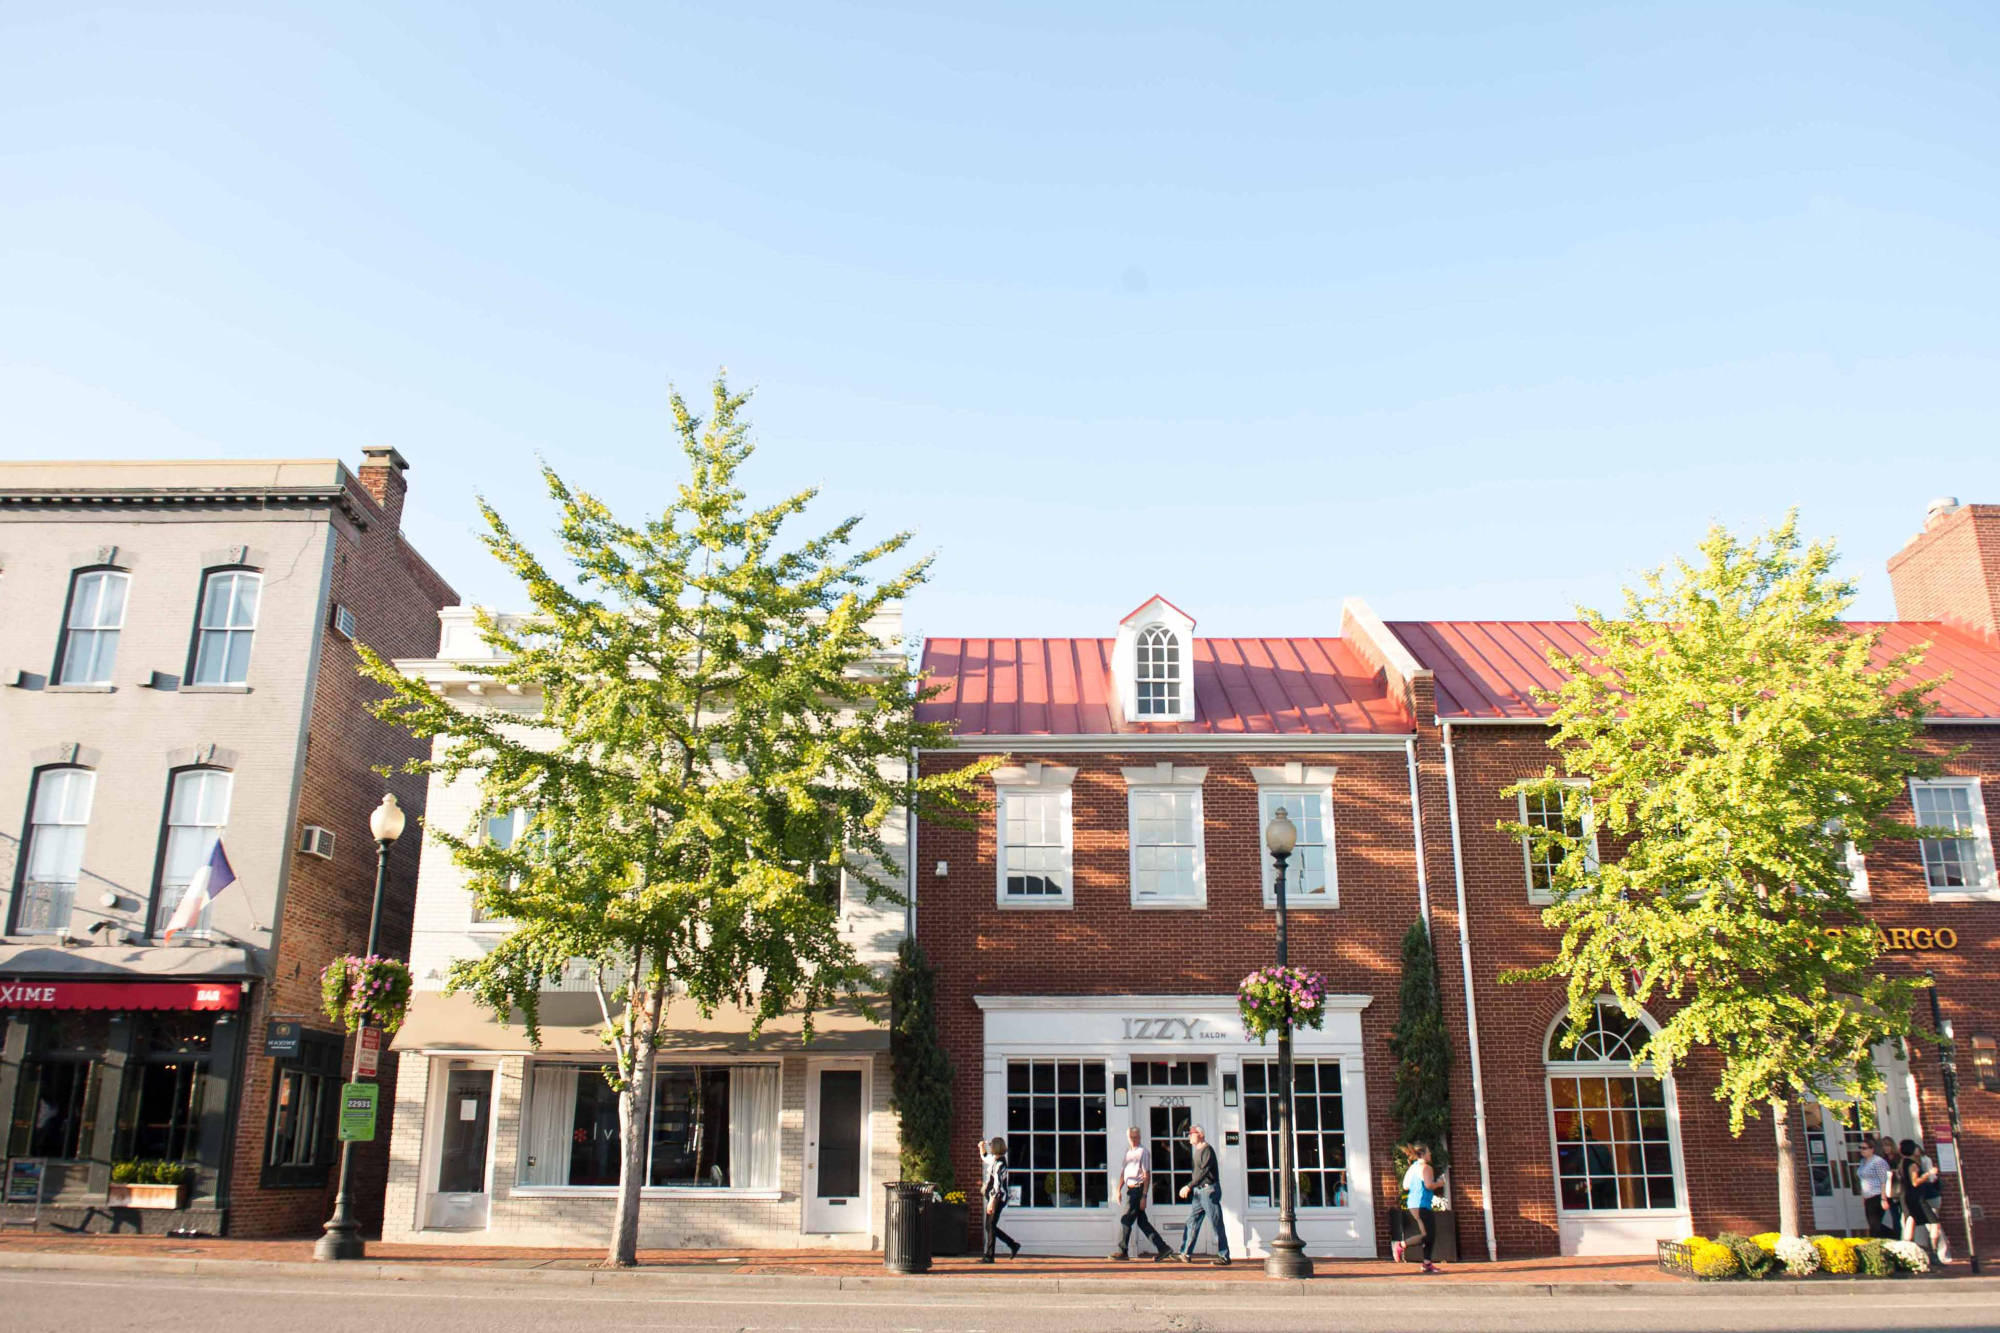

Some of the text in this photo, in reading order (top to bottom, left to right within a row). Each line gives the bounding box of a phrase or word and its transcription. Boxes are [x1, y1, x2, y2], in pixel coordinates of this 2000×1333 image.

[1858, 928, 1958, 950] ARGO
[0, 985, 56, 1003] XIME
[1121, 1018, 1227, 1040] IZZY SALON
[1159, 1096, 1185, 1107] 2903
